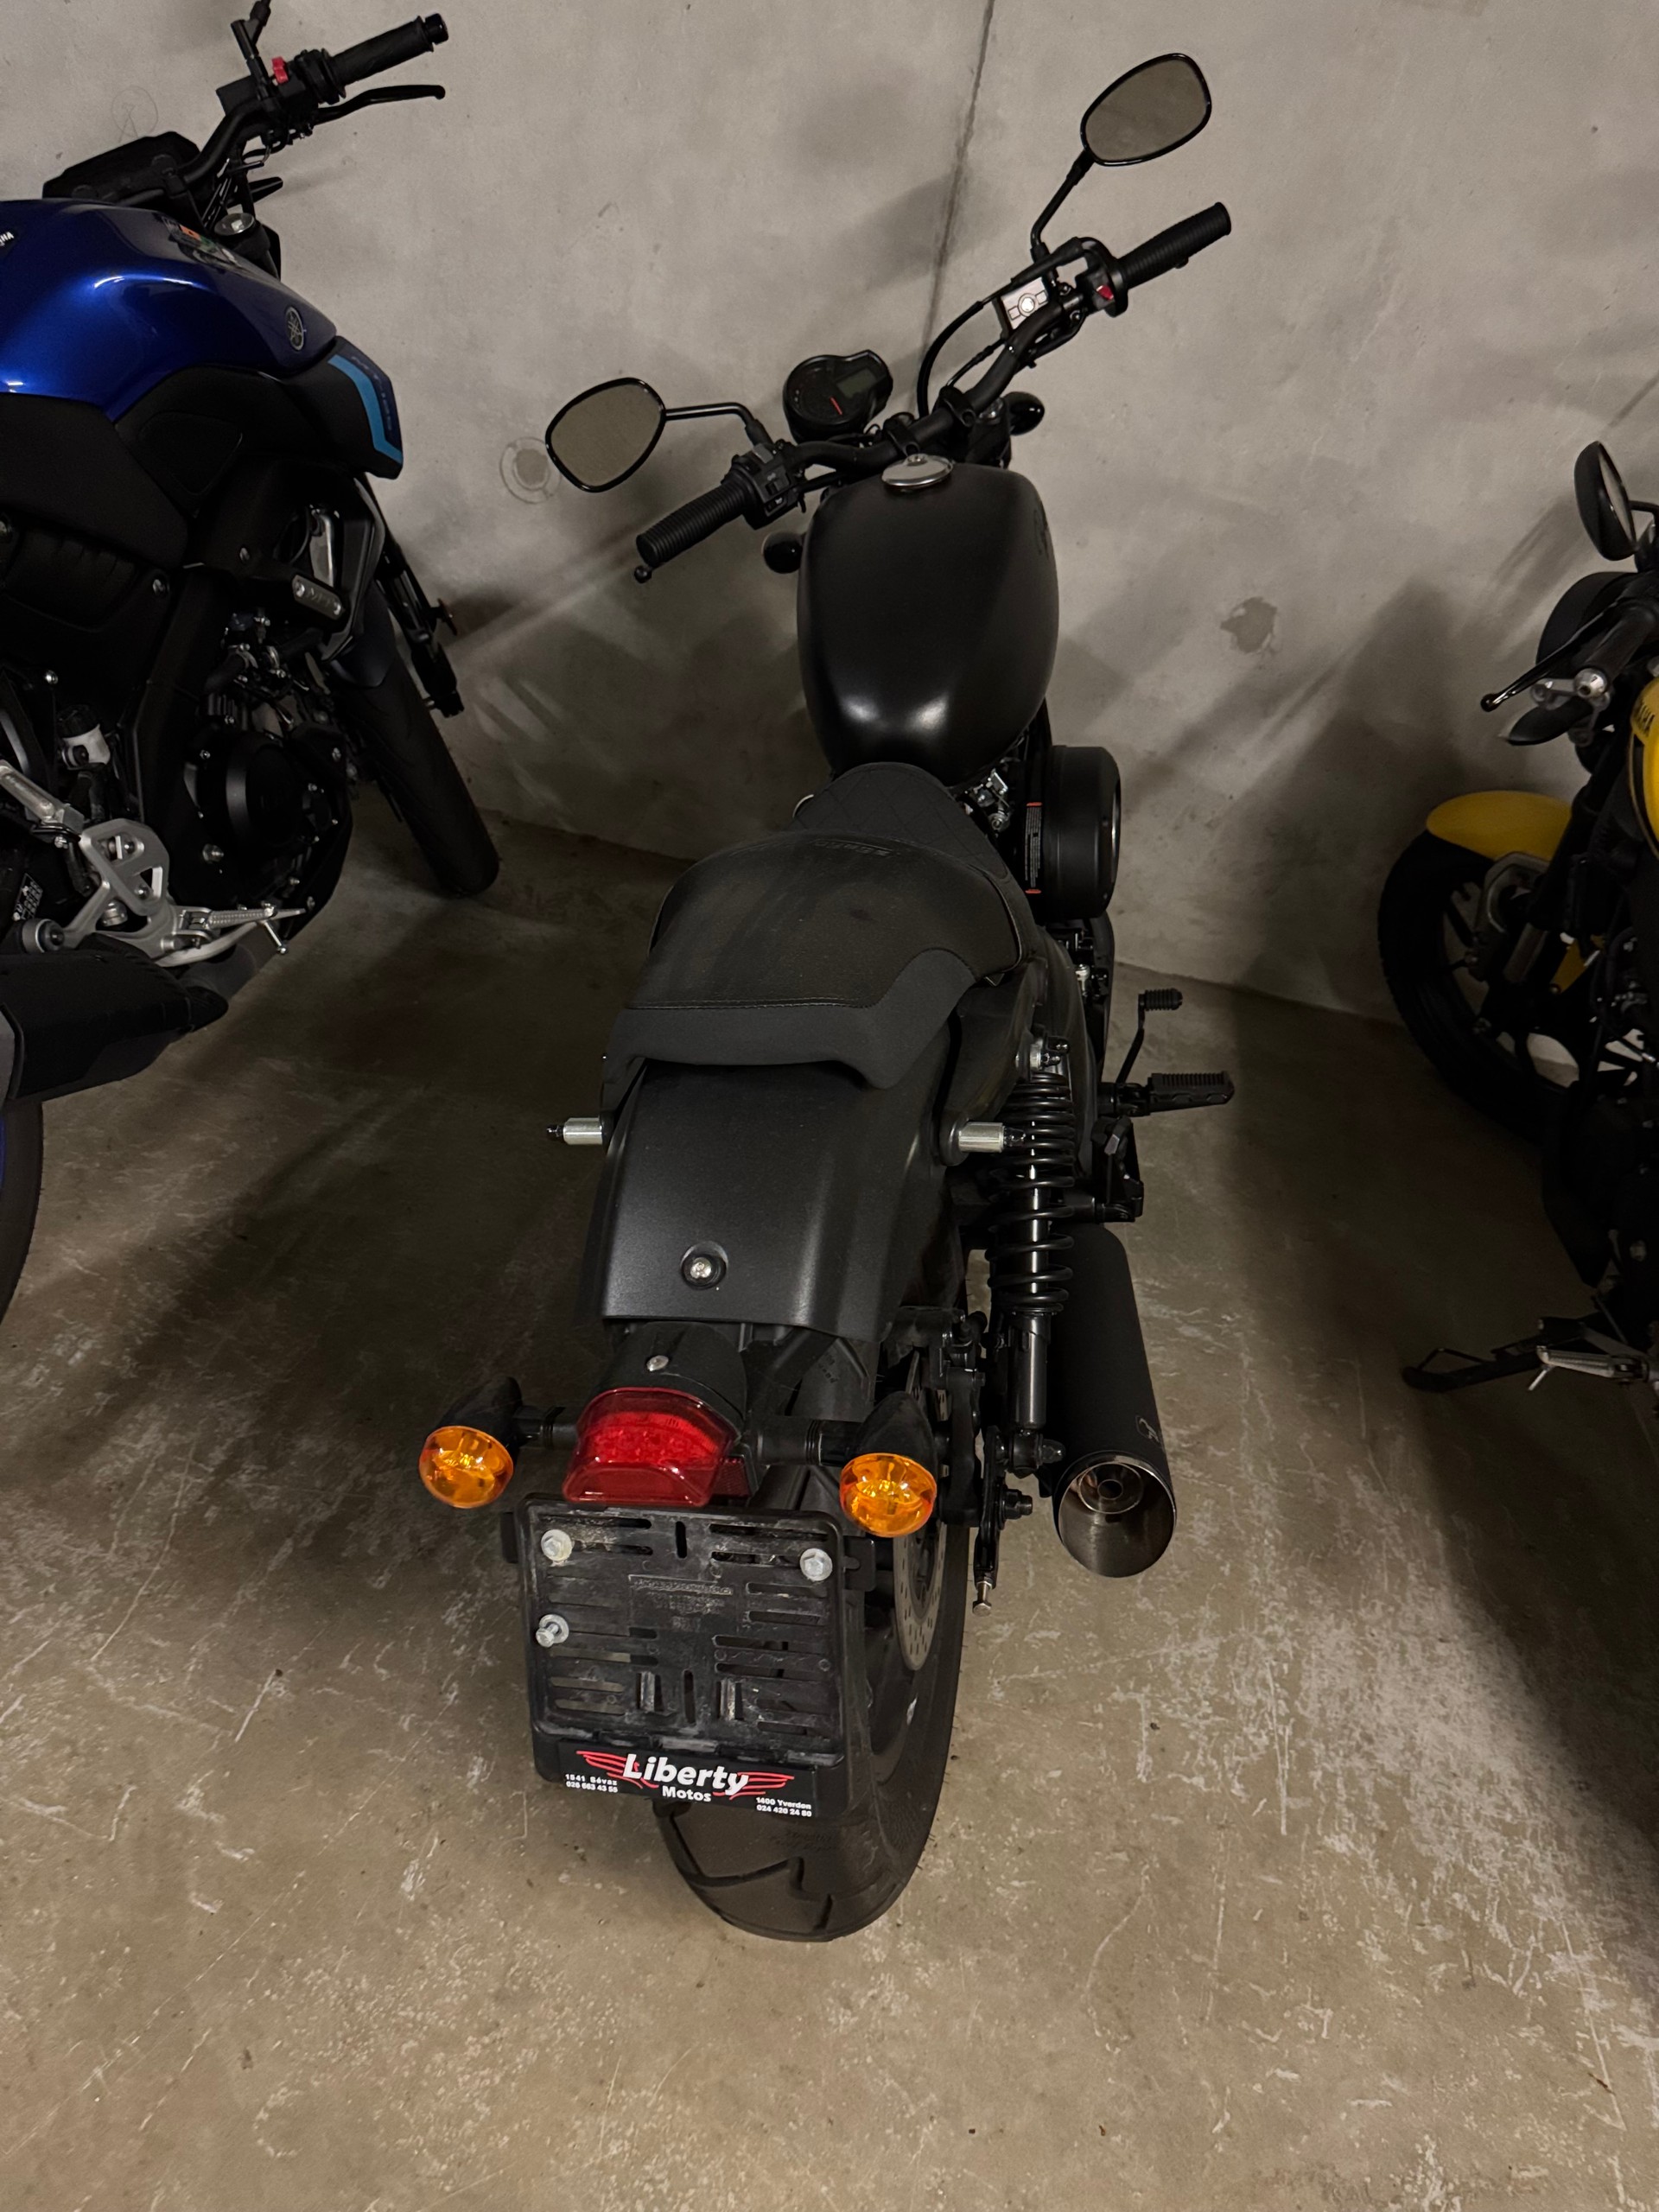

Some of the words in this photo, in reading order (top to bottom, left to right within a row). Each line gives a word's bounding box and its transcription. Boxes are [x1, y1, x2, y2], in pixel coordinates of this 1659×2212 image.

[622, 1753, 749, 1796] Liberty
[662, 1785, 712, 1802] Motos
[756, 1796, 776, 1806] 1400
[777, 1799, 812, 1810] Yverdon
[756, 1804, 772, 1813] 024
